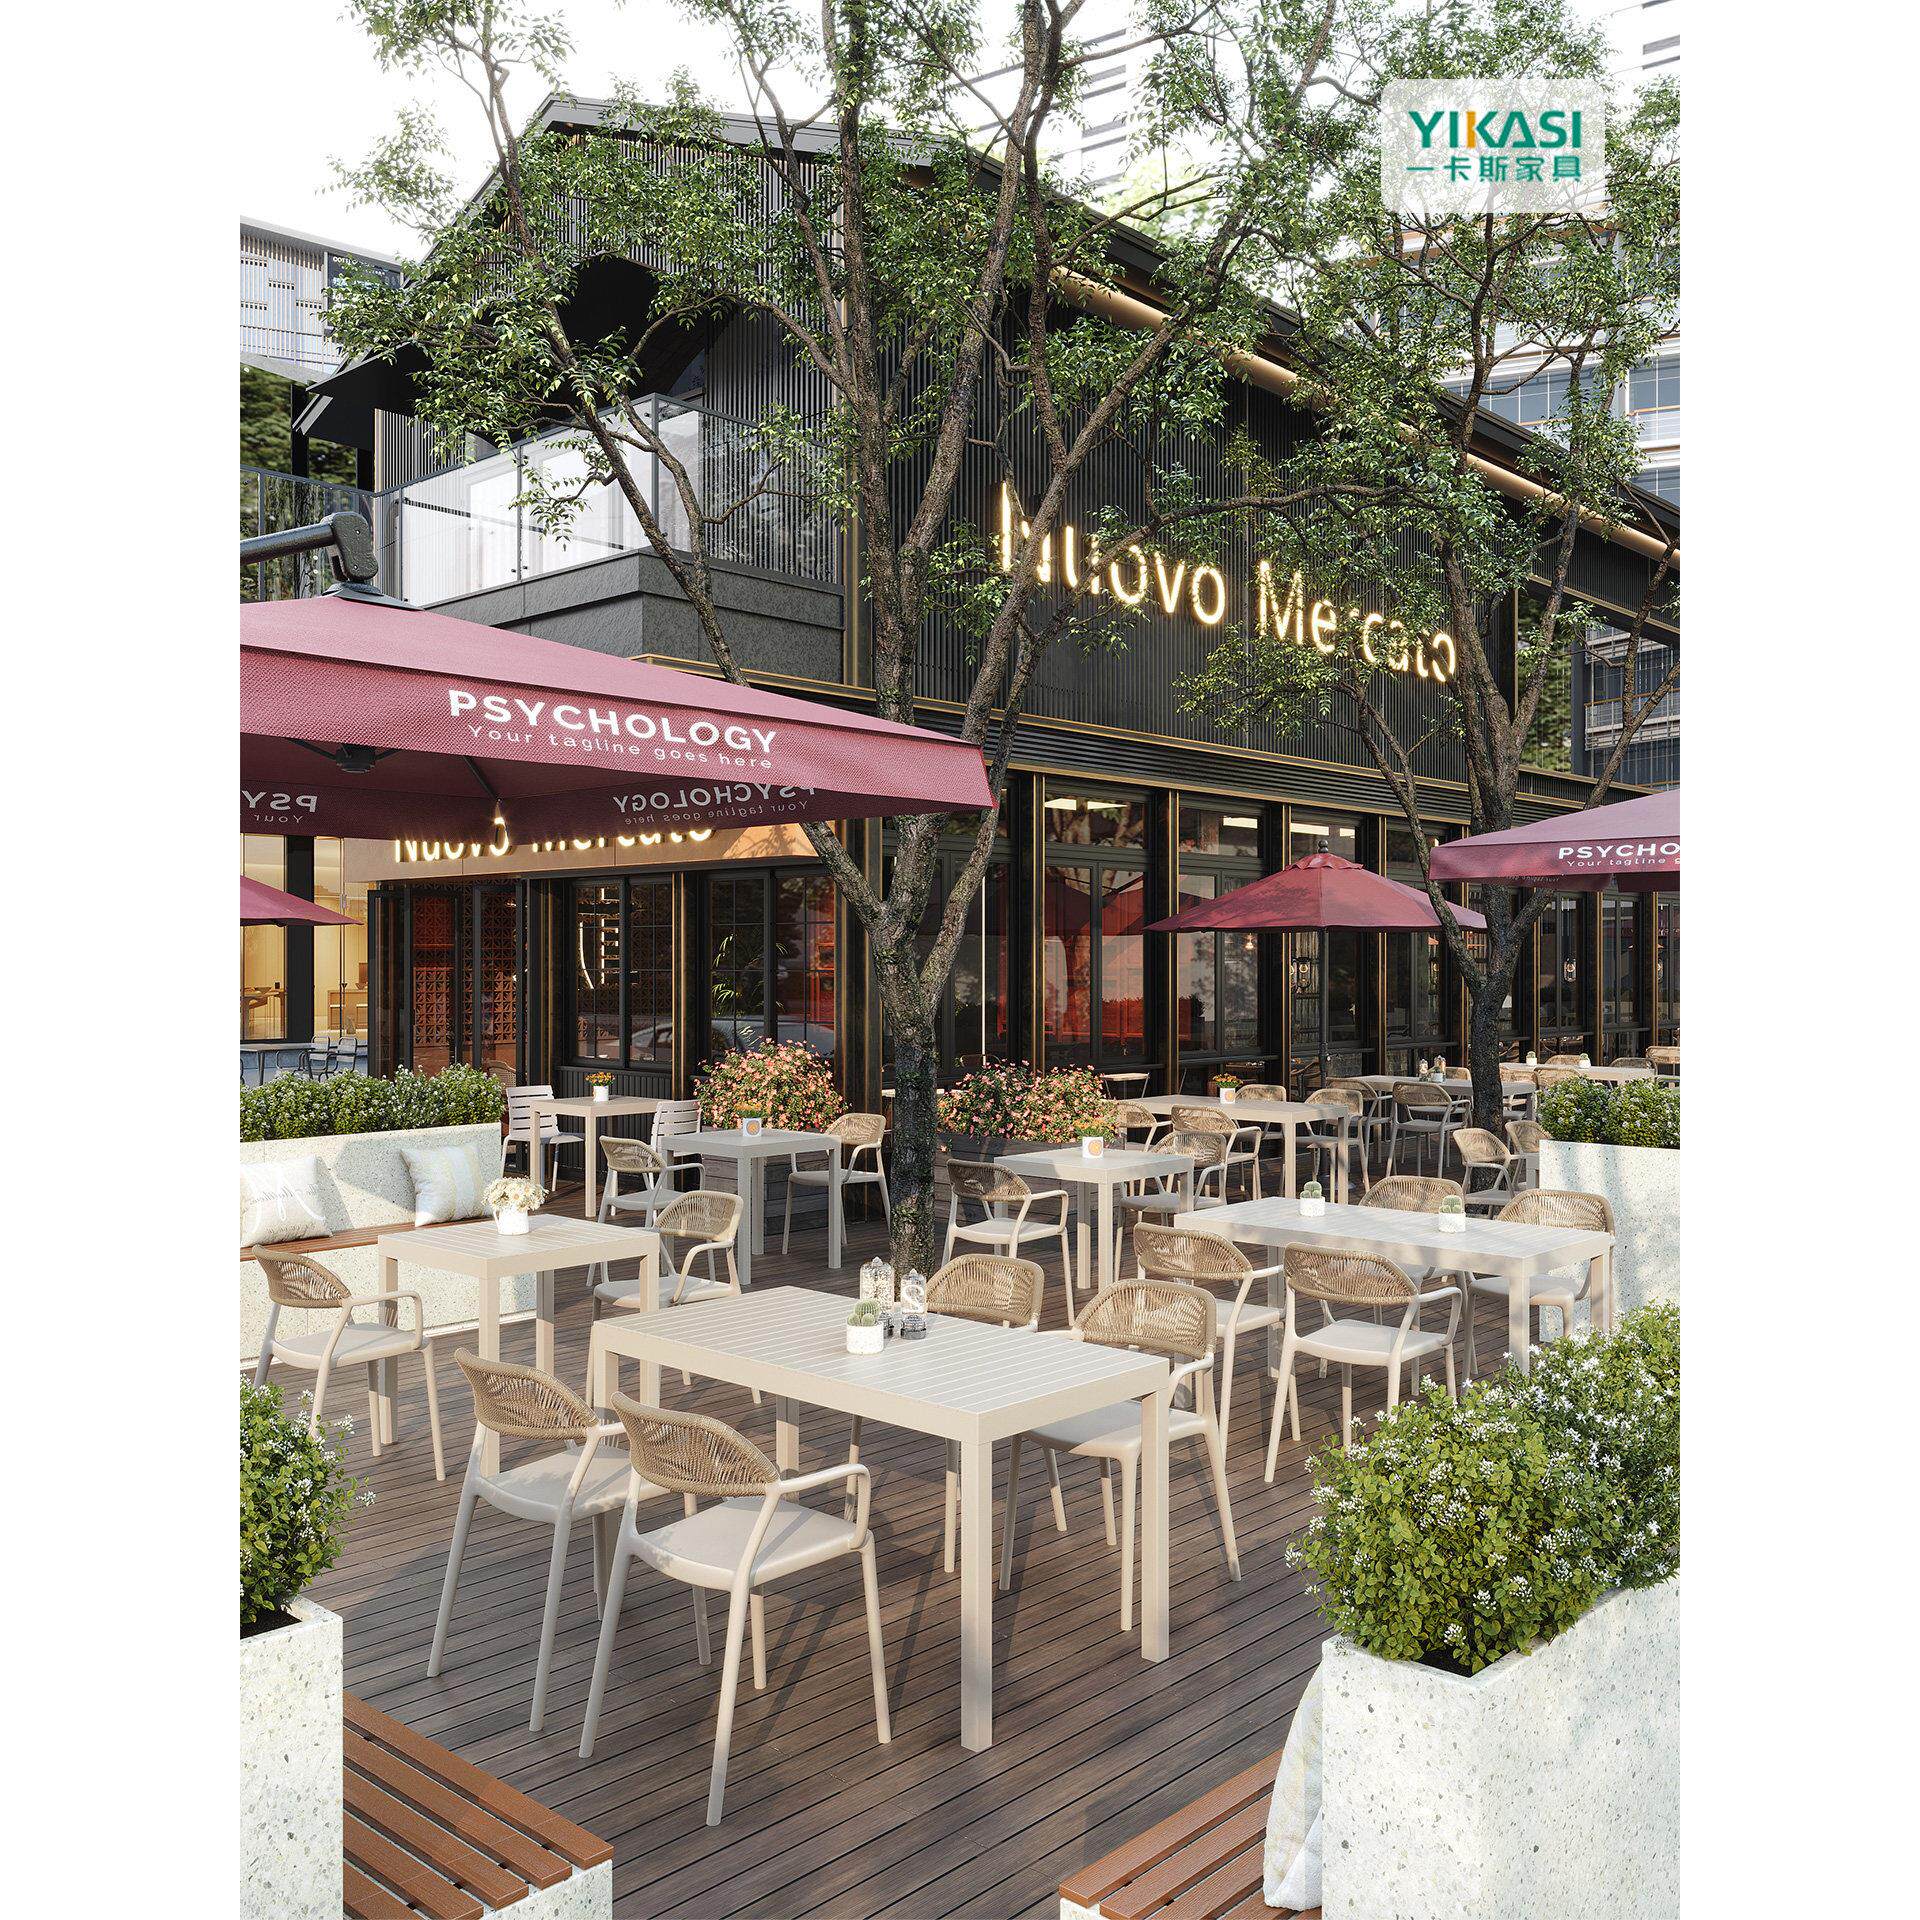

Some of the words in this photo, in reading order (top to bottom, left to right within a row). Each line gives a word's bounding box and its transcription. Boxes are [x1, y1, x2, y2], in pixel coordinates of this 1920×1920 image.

[1258, 560, 1456, 683] Mecato
[448, 689, 777, 753] PSYCHOLOGY
[468, 724, 534, 744] Your
[549, 733, 641, 755] tagline
[654, 747, 708, 763] goes
[719, 753, 772, 769] here
[1610, 857, 1666, 867] tagline
